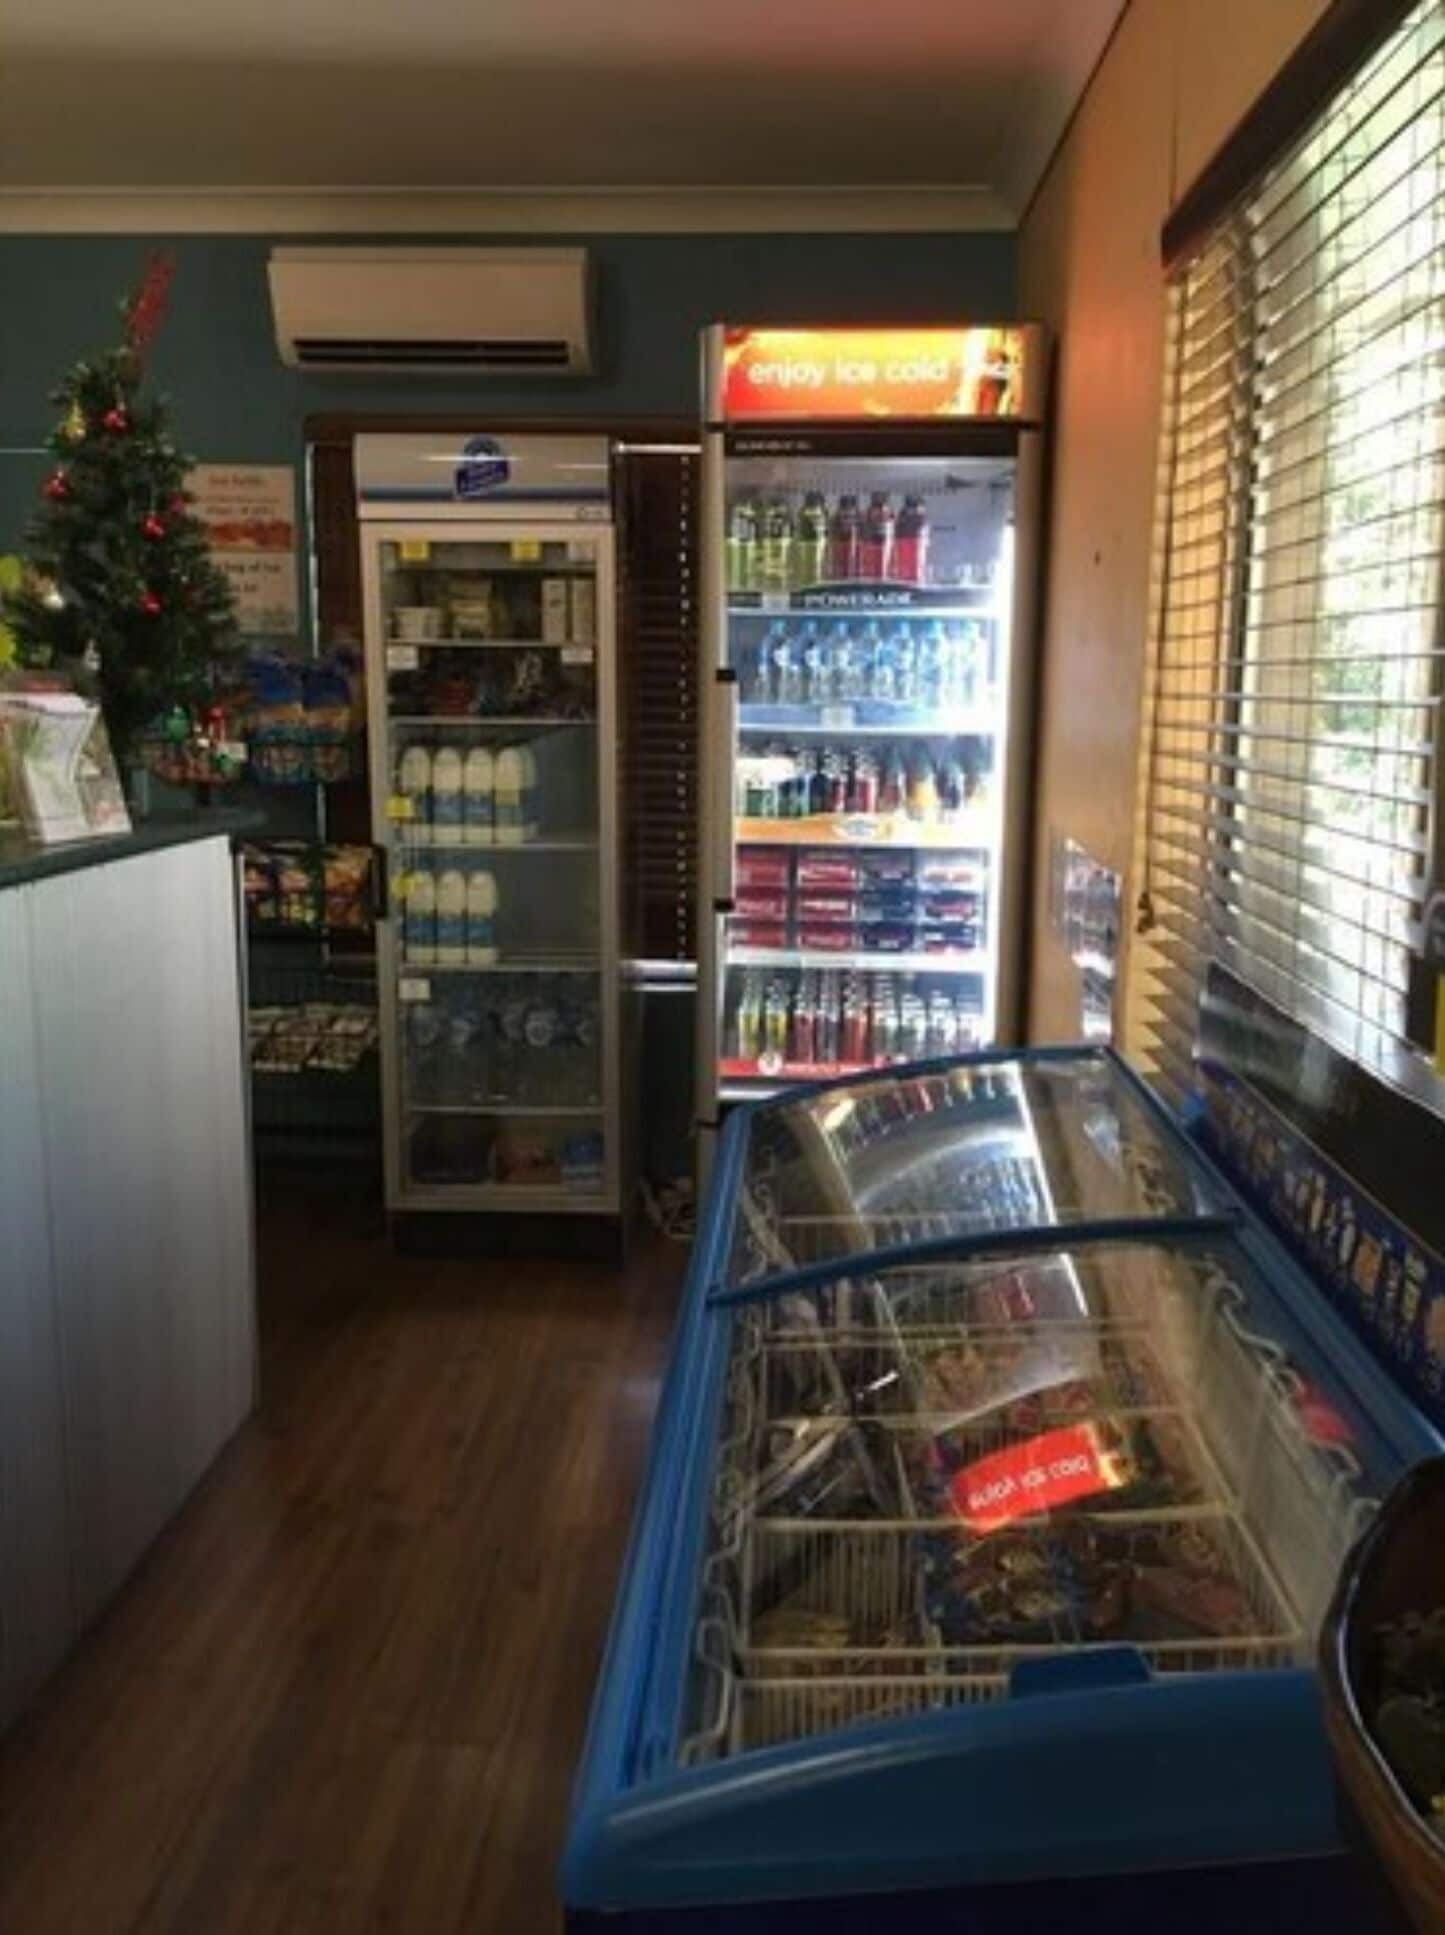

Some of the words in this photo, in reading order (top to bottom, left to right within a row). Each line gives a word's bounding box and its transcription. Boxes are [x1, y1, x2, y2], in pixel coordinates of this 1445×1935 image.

[749, 358, 825, 388] enjoy
[836, 357, 875, 382] ice
[887, 356, 947, 381] cold
